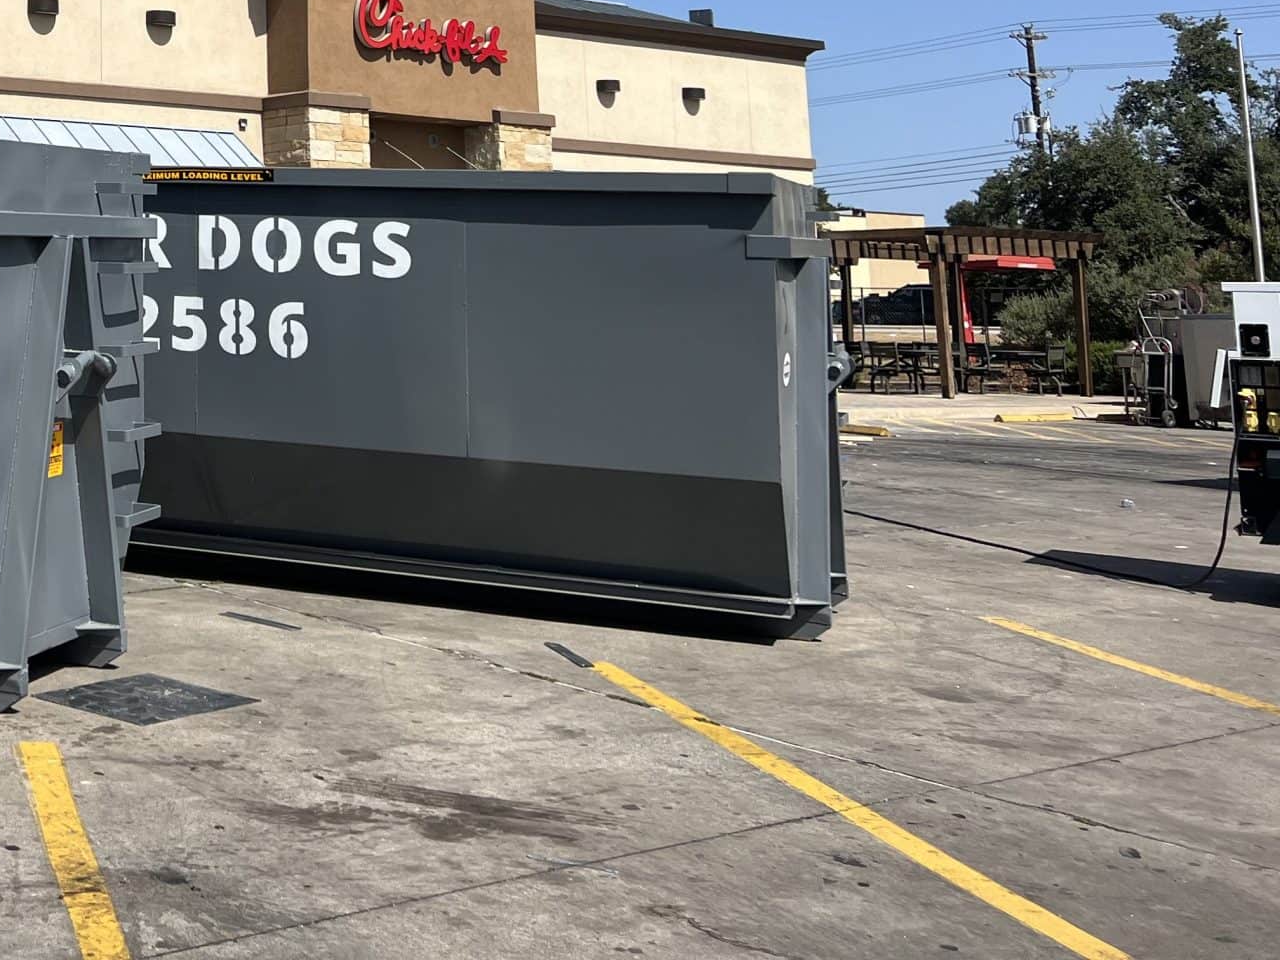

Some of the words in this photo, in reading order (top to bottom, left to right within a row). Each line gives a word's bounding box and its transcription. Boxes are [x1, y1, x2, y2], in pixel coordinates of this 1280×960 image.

[142, 172, 180, 180] XIMUM
[182, 172, 228, 180] LOADING
[231, 173, 264, 181] LEVEL
[198, 214, 413, 279] DOGS
